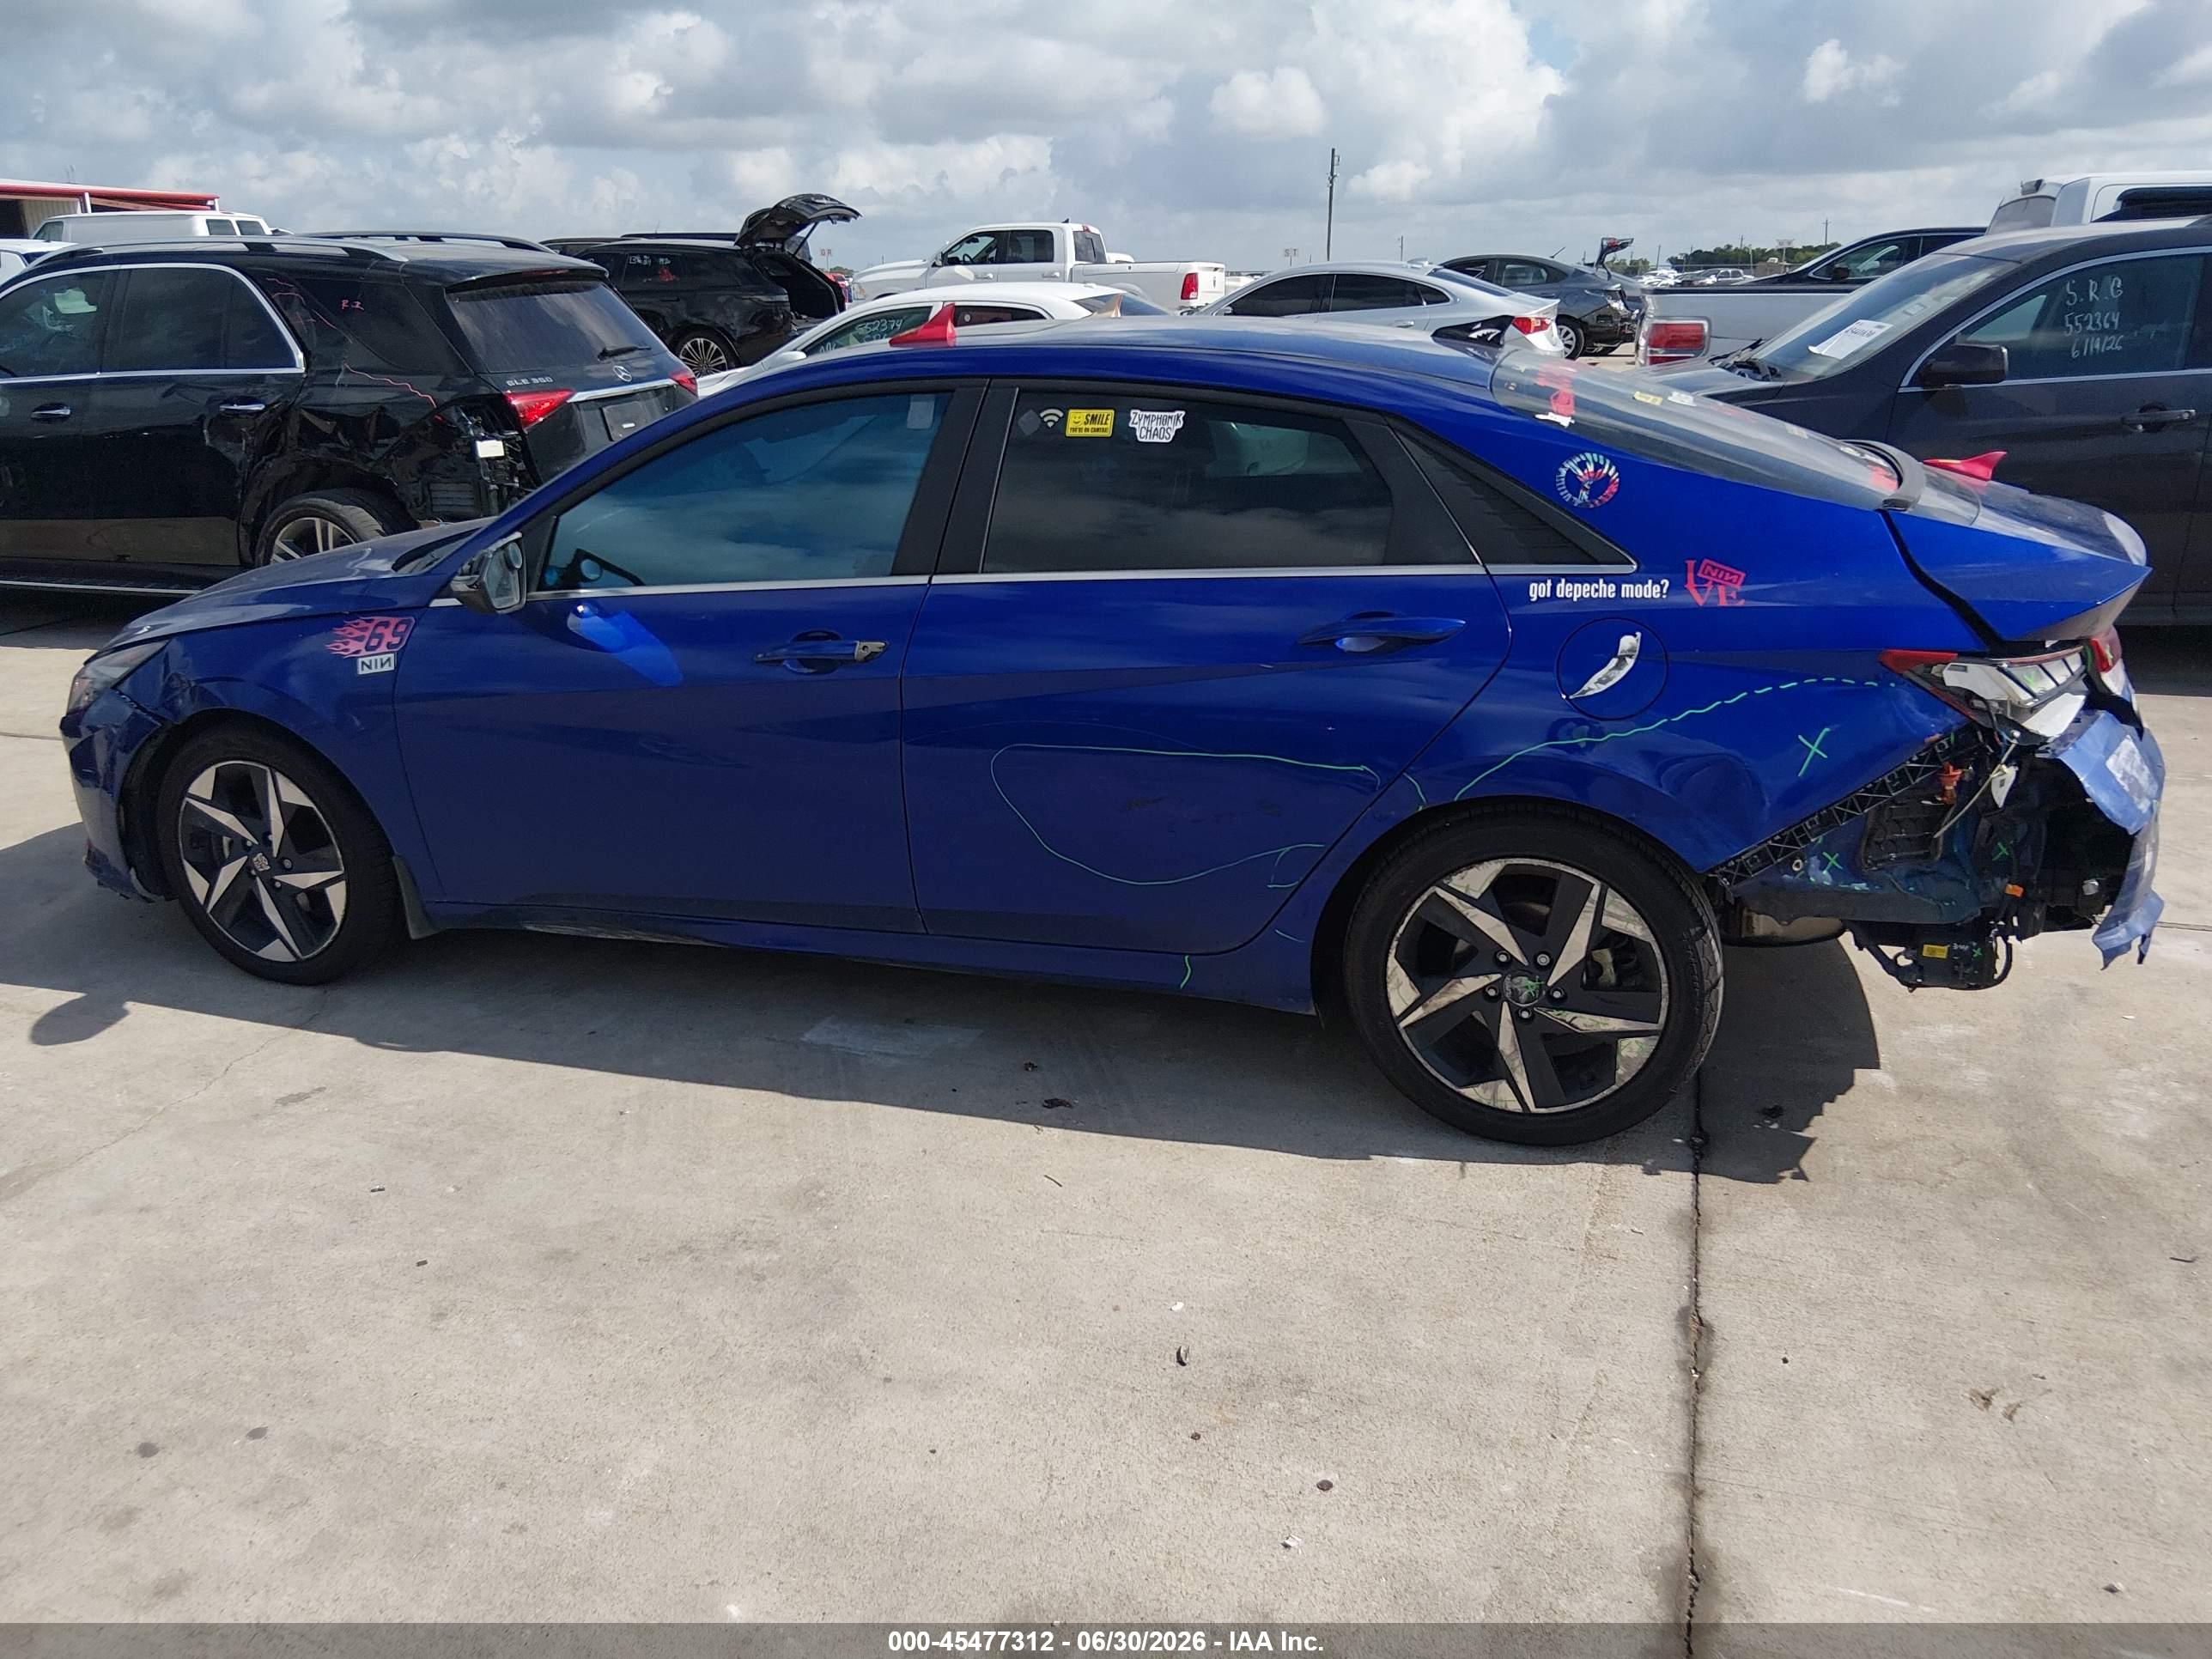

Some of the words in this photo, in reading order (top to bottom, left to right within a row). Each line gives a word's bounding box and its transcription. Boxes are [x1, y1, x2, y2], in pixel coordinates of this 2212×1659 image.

[2064, 312, 2120, 337] 552364
[1084, 413, 1111, 426] SMILE
[1139, 426, 1171, 440] CHAOS
[1528, 579, 1552, 602] got
[1556, 578, 1616, 602] depeche
[1621, 579, 1669, 599] mode?
[365, 618, 414, 653] 69
[361, 657, 392, 672] NIN
